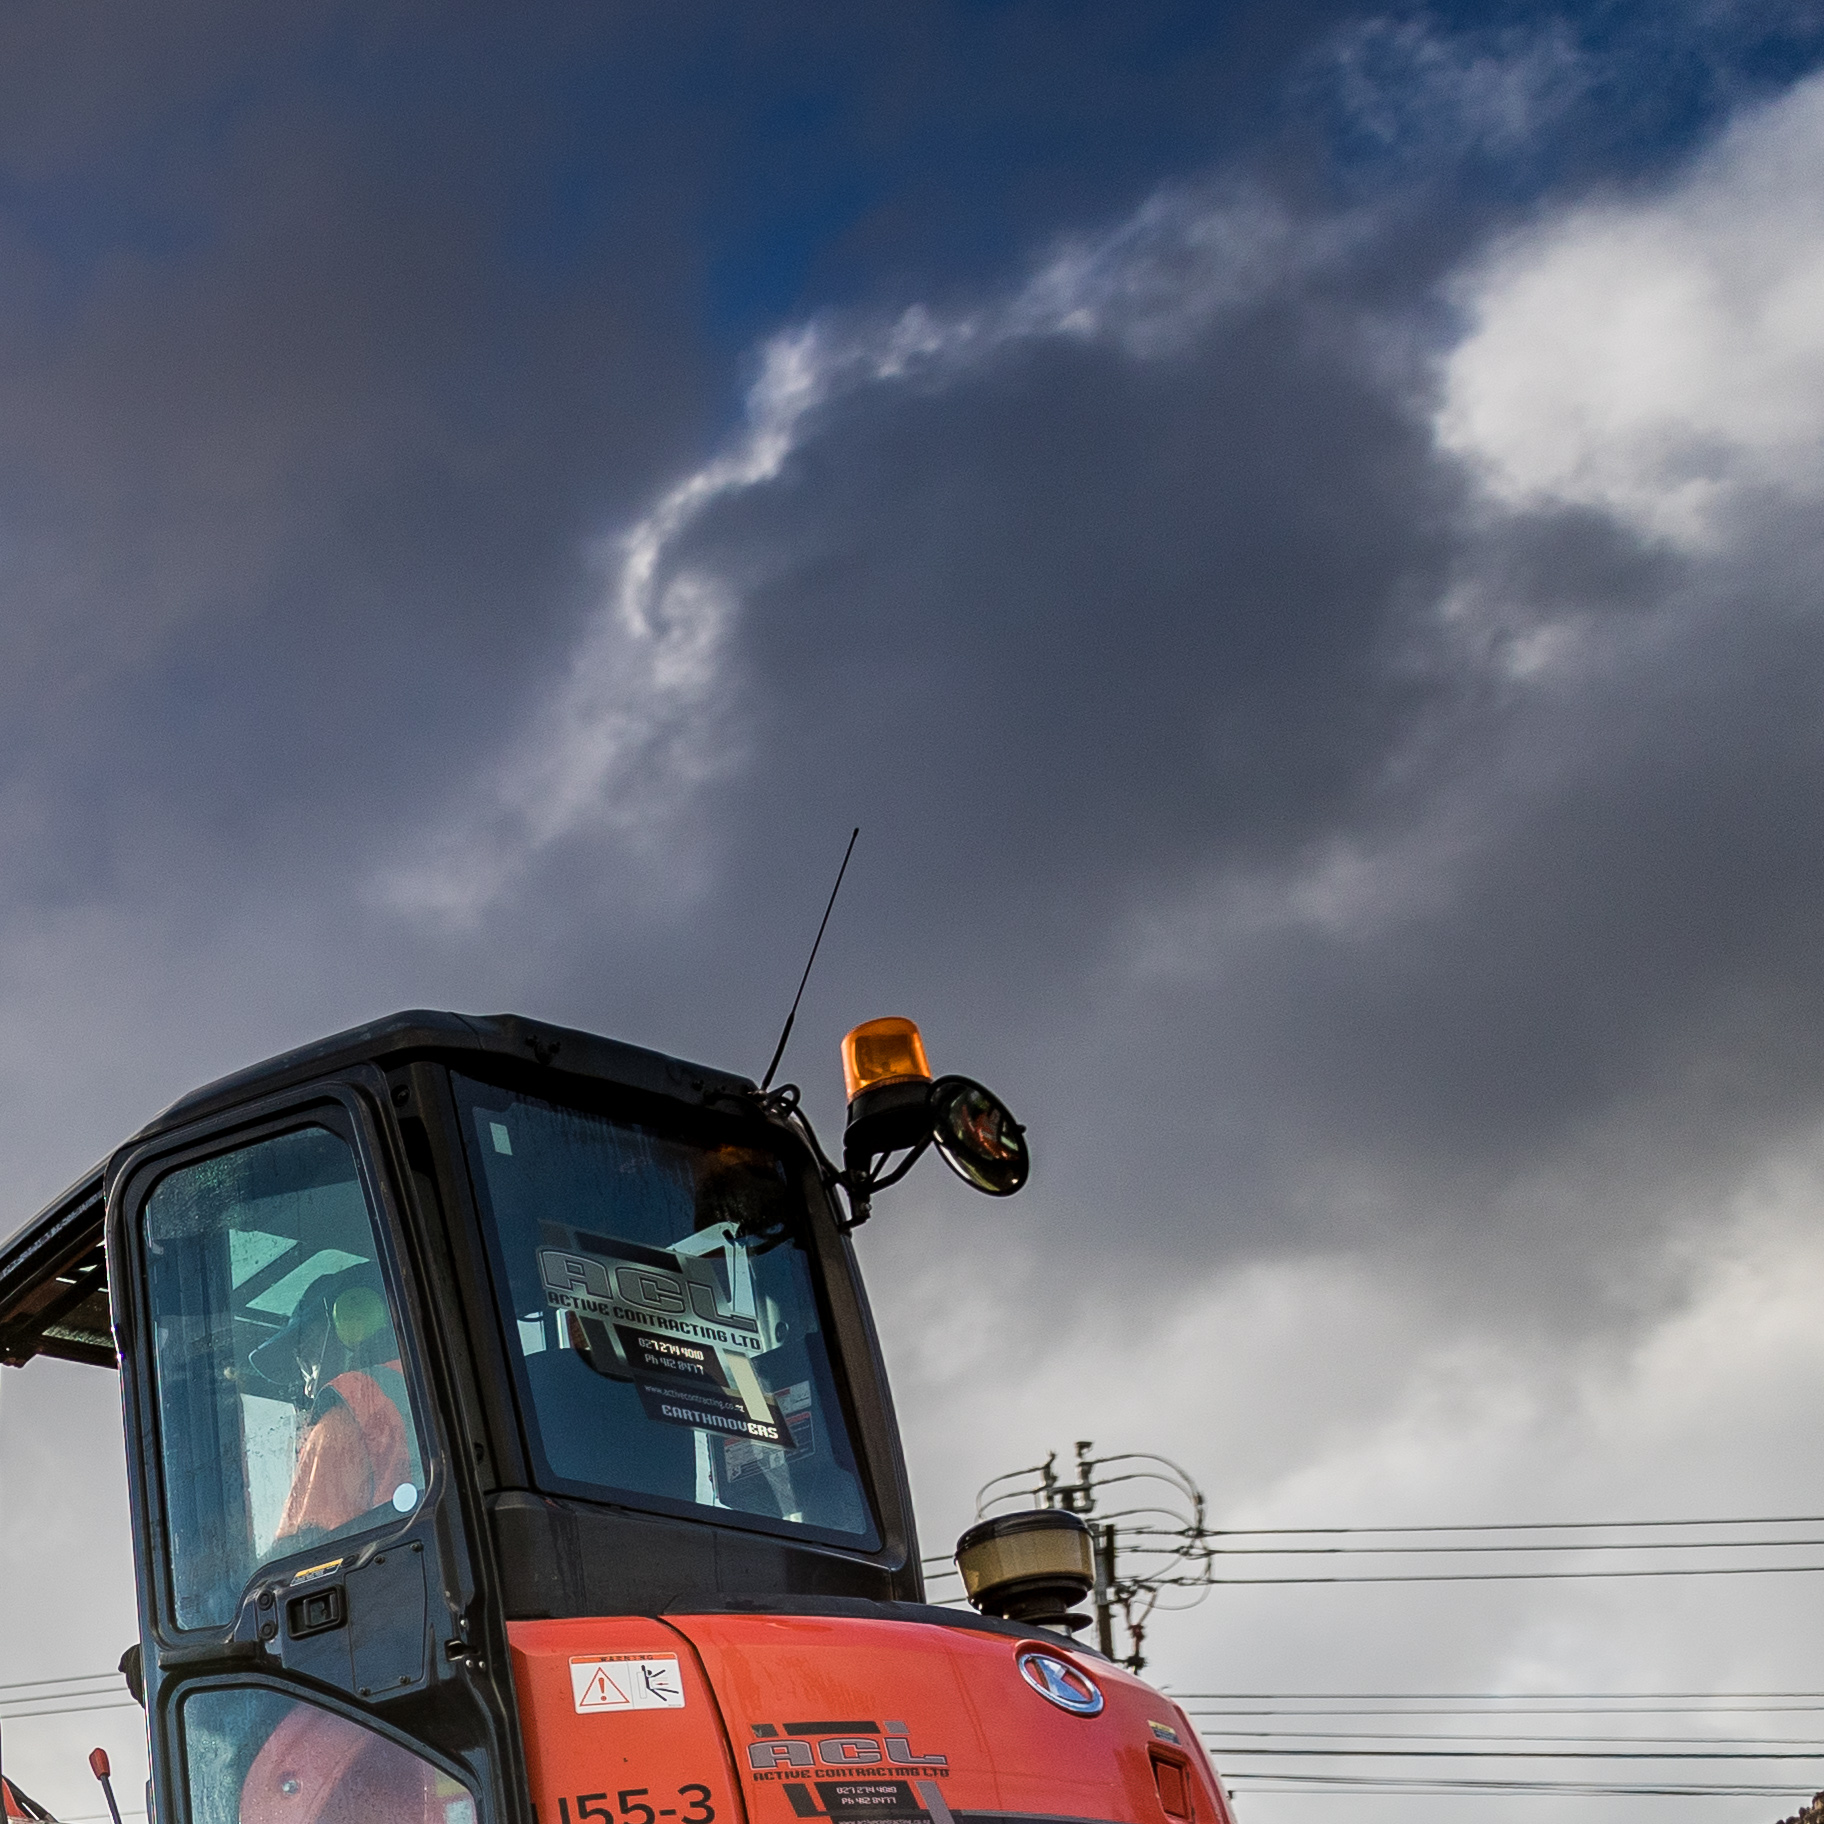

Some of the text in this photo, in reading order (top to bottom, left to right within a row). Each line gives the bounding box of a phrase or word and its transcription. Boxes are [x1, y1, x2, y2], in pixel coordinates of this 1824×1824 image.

[538, 1250, 759, 1333] ACL
[547, 1290, 762, 1351] ACTIVE CONTRACTING LTD
[638, 1337, 704, 1361] 027 274 4010
[644, 1353, 704, 1375] Ph 412 8477
[661, 1404, 779, 1440] EARTHMOVERS
[748, 1737, 948, 1770] ACL
[753, 1766, 950, 1781] ACTIVE CONTRACTING LTD
[836, 1786, 856, 1794] 027
